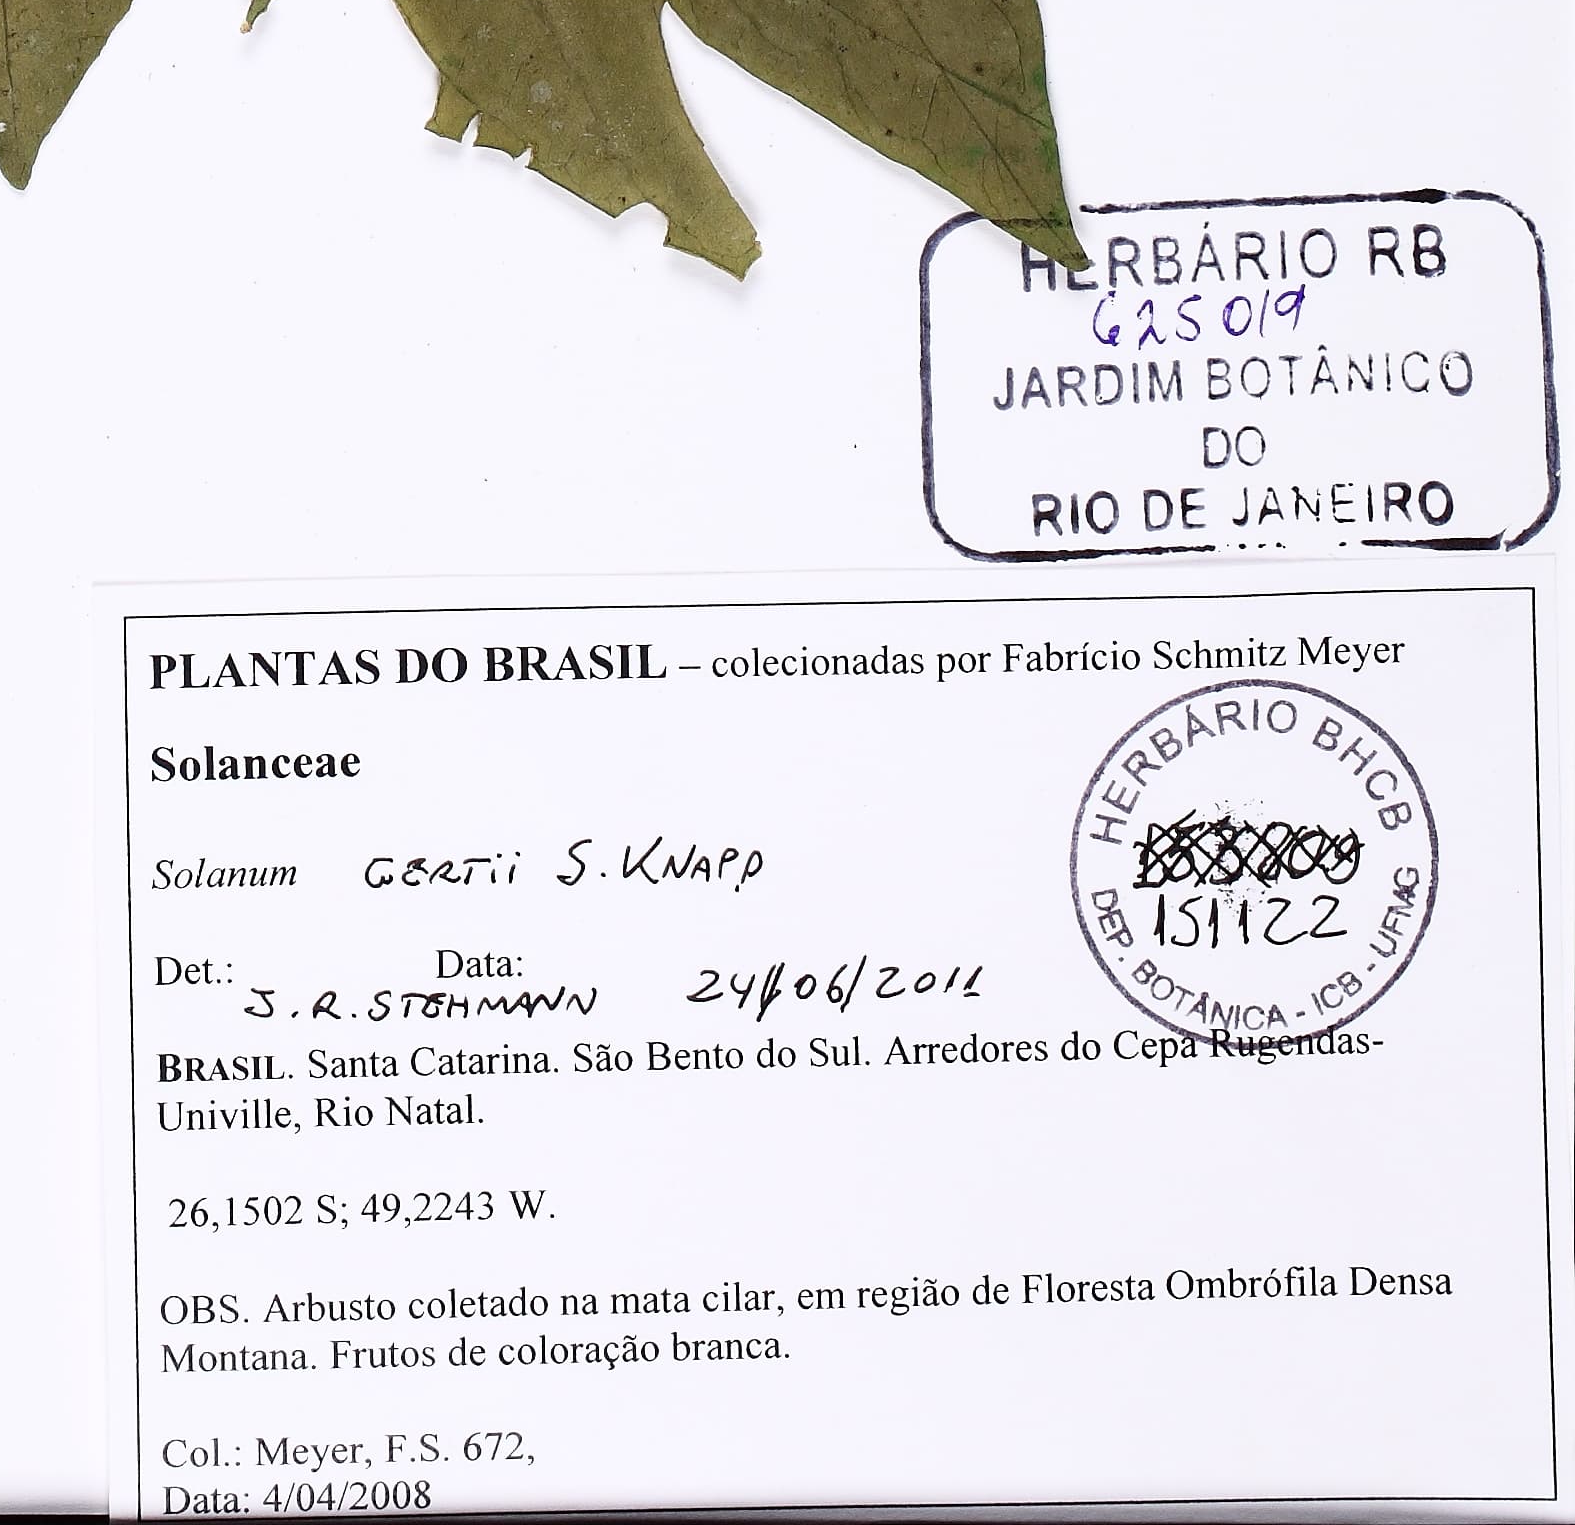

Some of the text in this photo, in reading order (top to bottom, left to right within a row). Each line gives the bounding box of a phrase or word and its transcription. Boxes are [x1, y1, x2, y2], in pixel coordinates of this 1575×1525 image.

[1368, 225, 1447, 278] RB
[993, 345, 1472, 410] JARDIM BOTÂNICO
[1203, 426, 1266, 469] DO
[1032, 481, 1454, 536] RIO DE JANEIRO
[149, 650, 380, 689] PLANTAS
[395, 648, 467, 683] DO
[483, 644, 667, 681] BRASIL
[712, 645, 924, 677] colecionadas
[937, 653, 991, 682] por
[1003, 641, 1140, 672] Fabrício
[1154, 638, 1286, 669] Schmitz
[1298, 636, 1405, 672] Meyer
[152, 746, 360, 782] Solanceae
[1090, 699, 1413, 845] HERBÁRIO BHCB
[152, 858, 296, 889] Solanum
[1154, 893, 1348, 948] 151122
[155, 957, 232, 985] Det.:
[436, 950, 522, 978] Data:
[1131, 958, 1288, 1031] BOTÂNICA
[1311, 971, 1362, 1015] ICB
[156, 1026, 1385, 1082] BRASIL. Santa Catarina. São Bento do Sul. Arredores do Cepa Rugendas-
[157, 1094, 483, 1134] Univille, Rio Natal.
[169, 1190, 554, 1233] 26,1502 S; 49,2243 W.
[161, 1266, 1453, 1324] OBS. Arbusto coletado na mata cilar, em região de Floresta Ombrófila Densa
[161, 1332, 789, 1372] Montana. Frutos de coloração branca.
[163, 1432, 534, 1472] Col.: Meyer, F.S. 672,
[163, 1480, 431, 1515] Data: 4/04/2008
